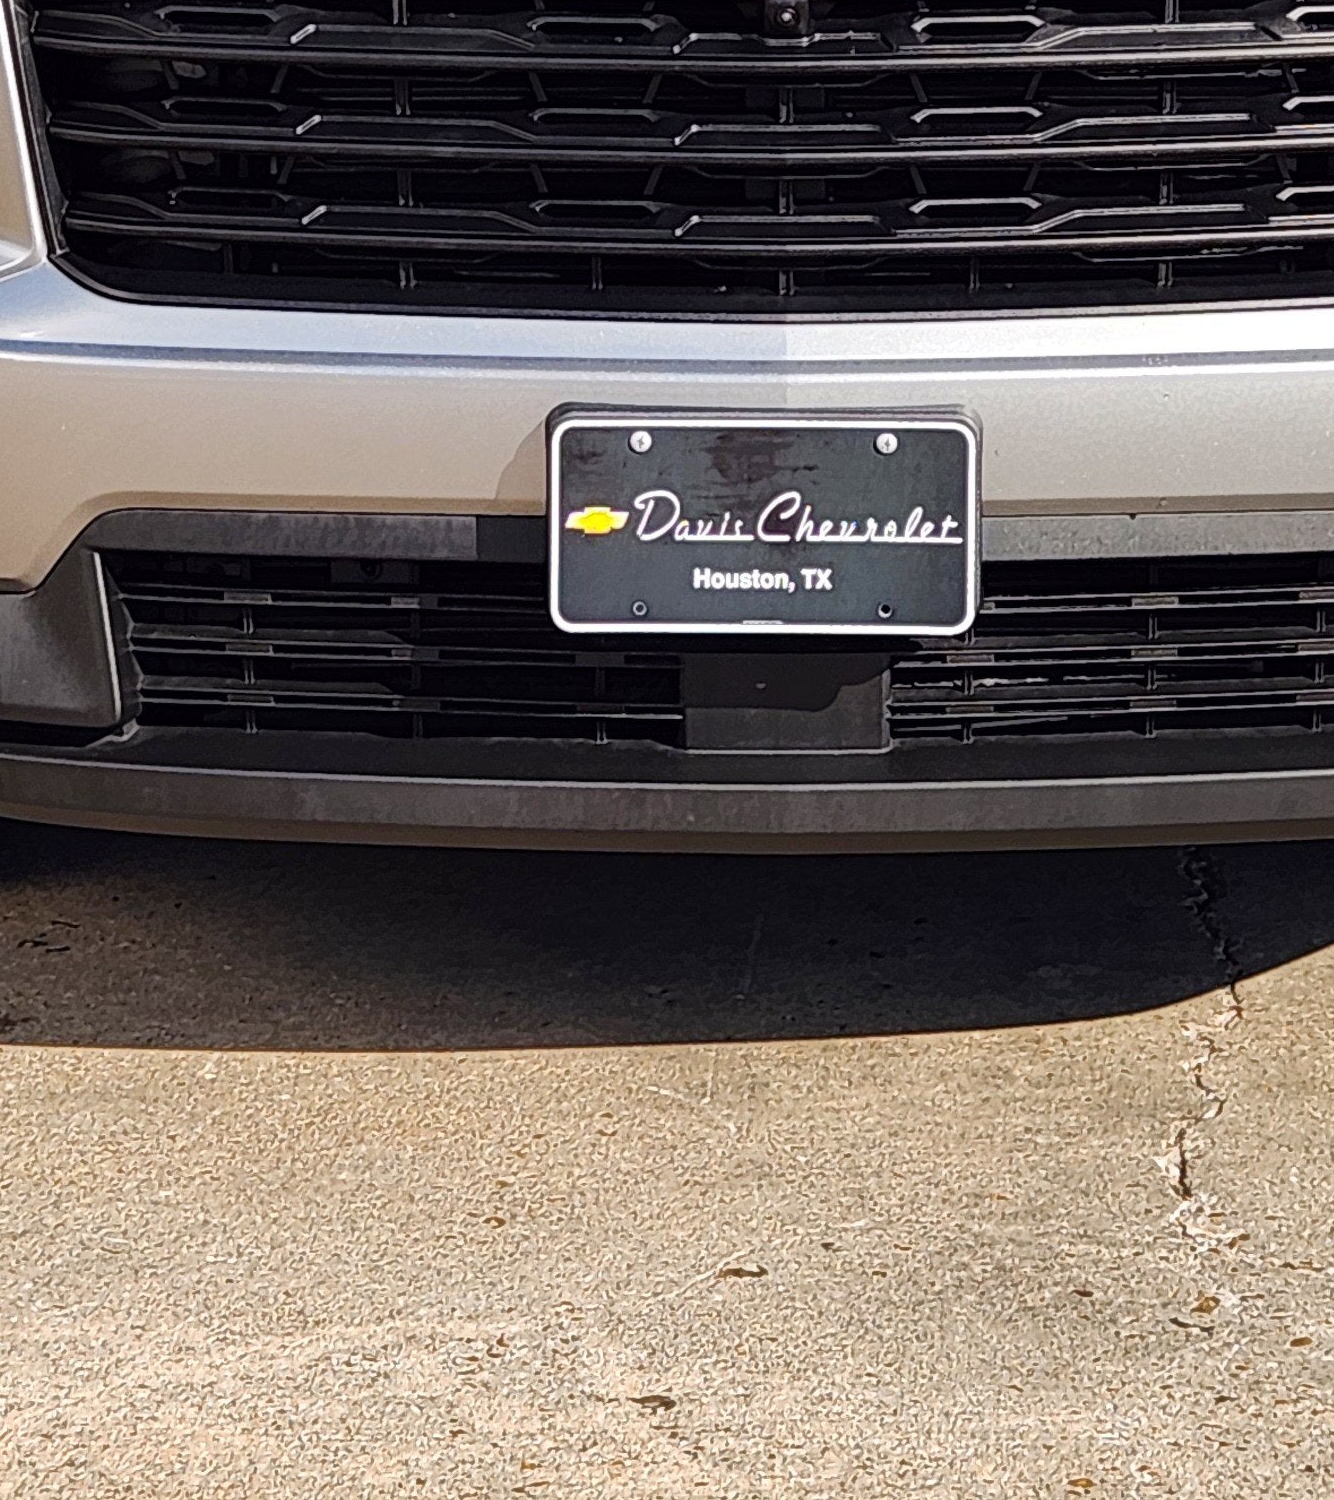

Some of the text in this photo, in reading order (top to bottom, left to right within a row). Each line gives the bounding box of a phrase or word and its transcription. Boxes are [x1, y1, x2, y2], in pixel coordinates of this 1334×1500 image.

[634, 490, 963, 543] Davis Chevrolet
[693, 568, 832, 592] Houston, TX
